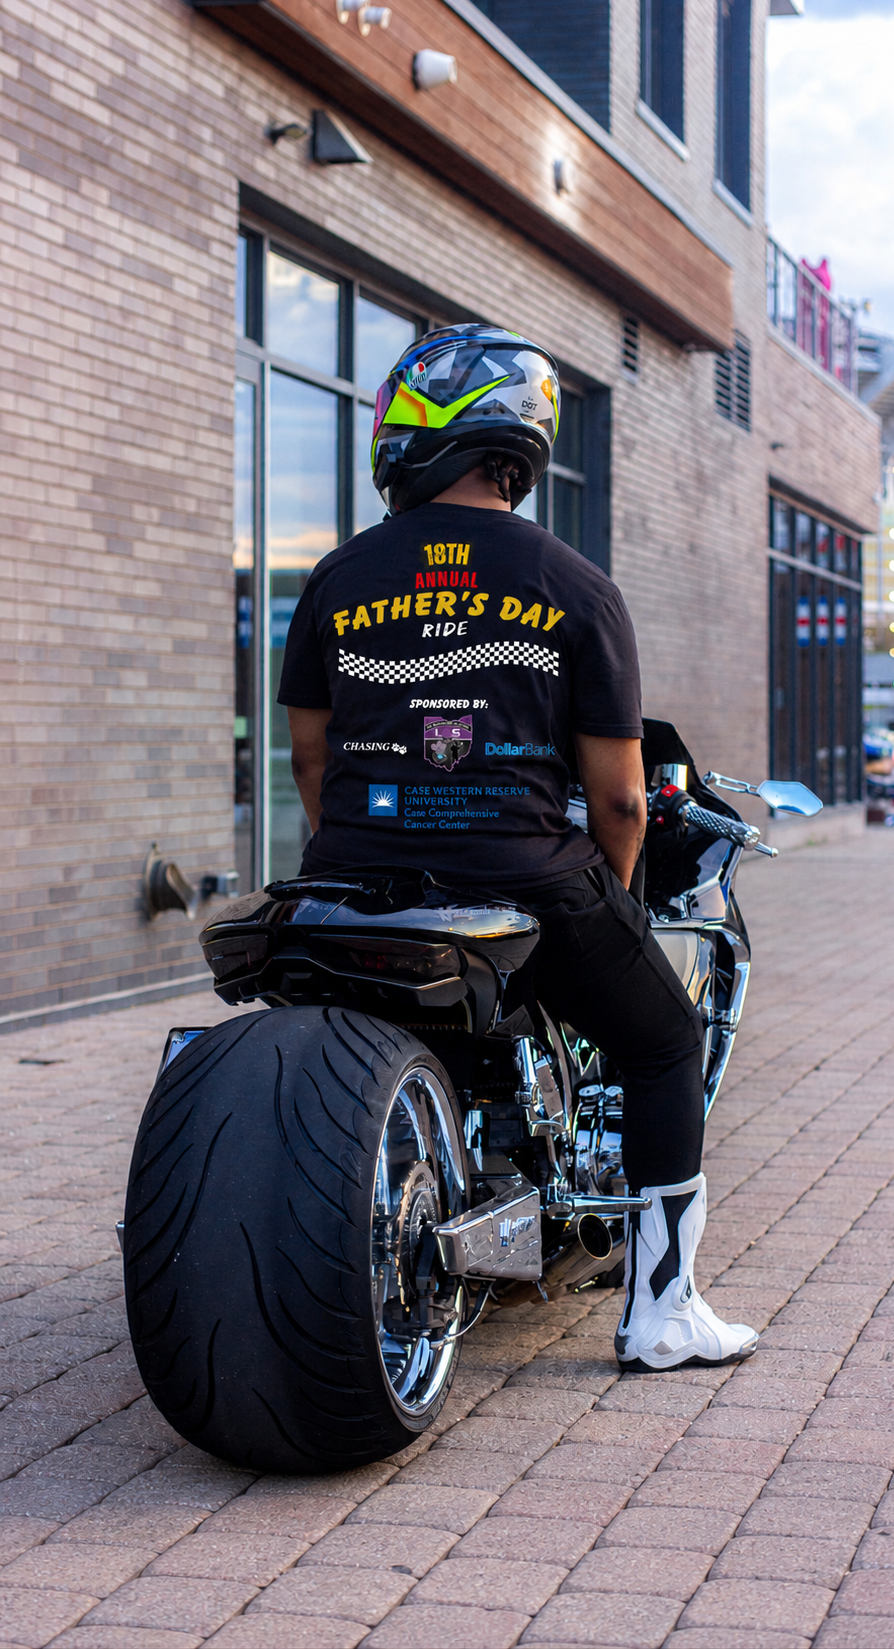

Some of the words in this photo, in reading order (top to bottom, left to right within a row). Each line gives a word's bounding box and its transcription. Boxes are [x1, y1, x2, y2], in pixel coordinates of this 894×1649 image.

[521, 399, 538, 411] DOT
[424, 543, 470, 566] 18TH
[415, 570, 478, 589] ANNUAL
[333, 591, 489, 636] FATHER'S
[499, 596, 565, 631] DAY
[422, 621, 468, 638] RIDE
[409, 699, 470, 709] SPONSORED
[472, 699, 489, 709] BY:
[343, 742, 390, 751] CHASING
[404, 786, 430, 795] CASE
[432, 786, 483, 795] WESTERN
[485, 786, 530, 795] RESERVE
[404, 797, 467, 806] UNIVERSITY
[404, 808, 426, 817] Case
[428, 808, 499, 819] Comprehensive
[404, 820, 437, 829] Cancer
[439, 820, 470, 830] Center
